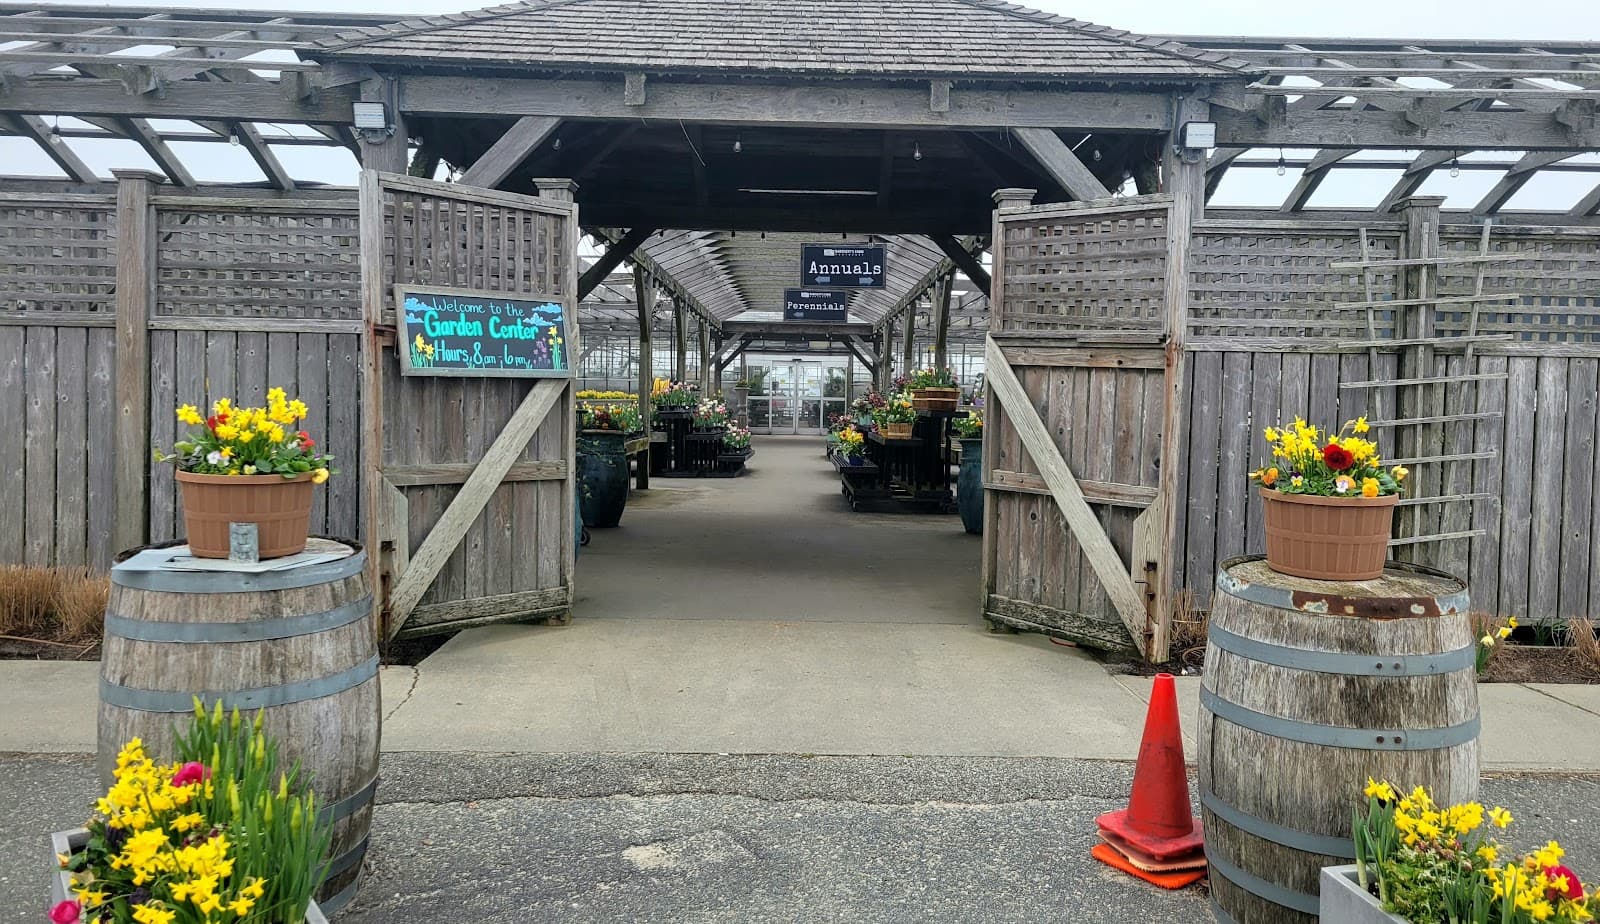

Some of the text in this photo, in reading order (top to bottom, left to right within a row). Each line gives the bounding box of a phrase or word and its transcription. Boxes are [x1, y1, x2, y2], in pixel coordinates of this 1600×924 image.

[808, 260, 882, 275] Annuals
[433, 297, 525, 317] Welcome to the
[787, 301, 845, 311] Perennials
[424, 311, 539, 340] Garden Center
